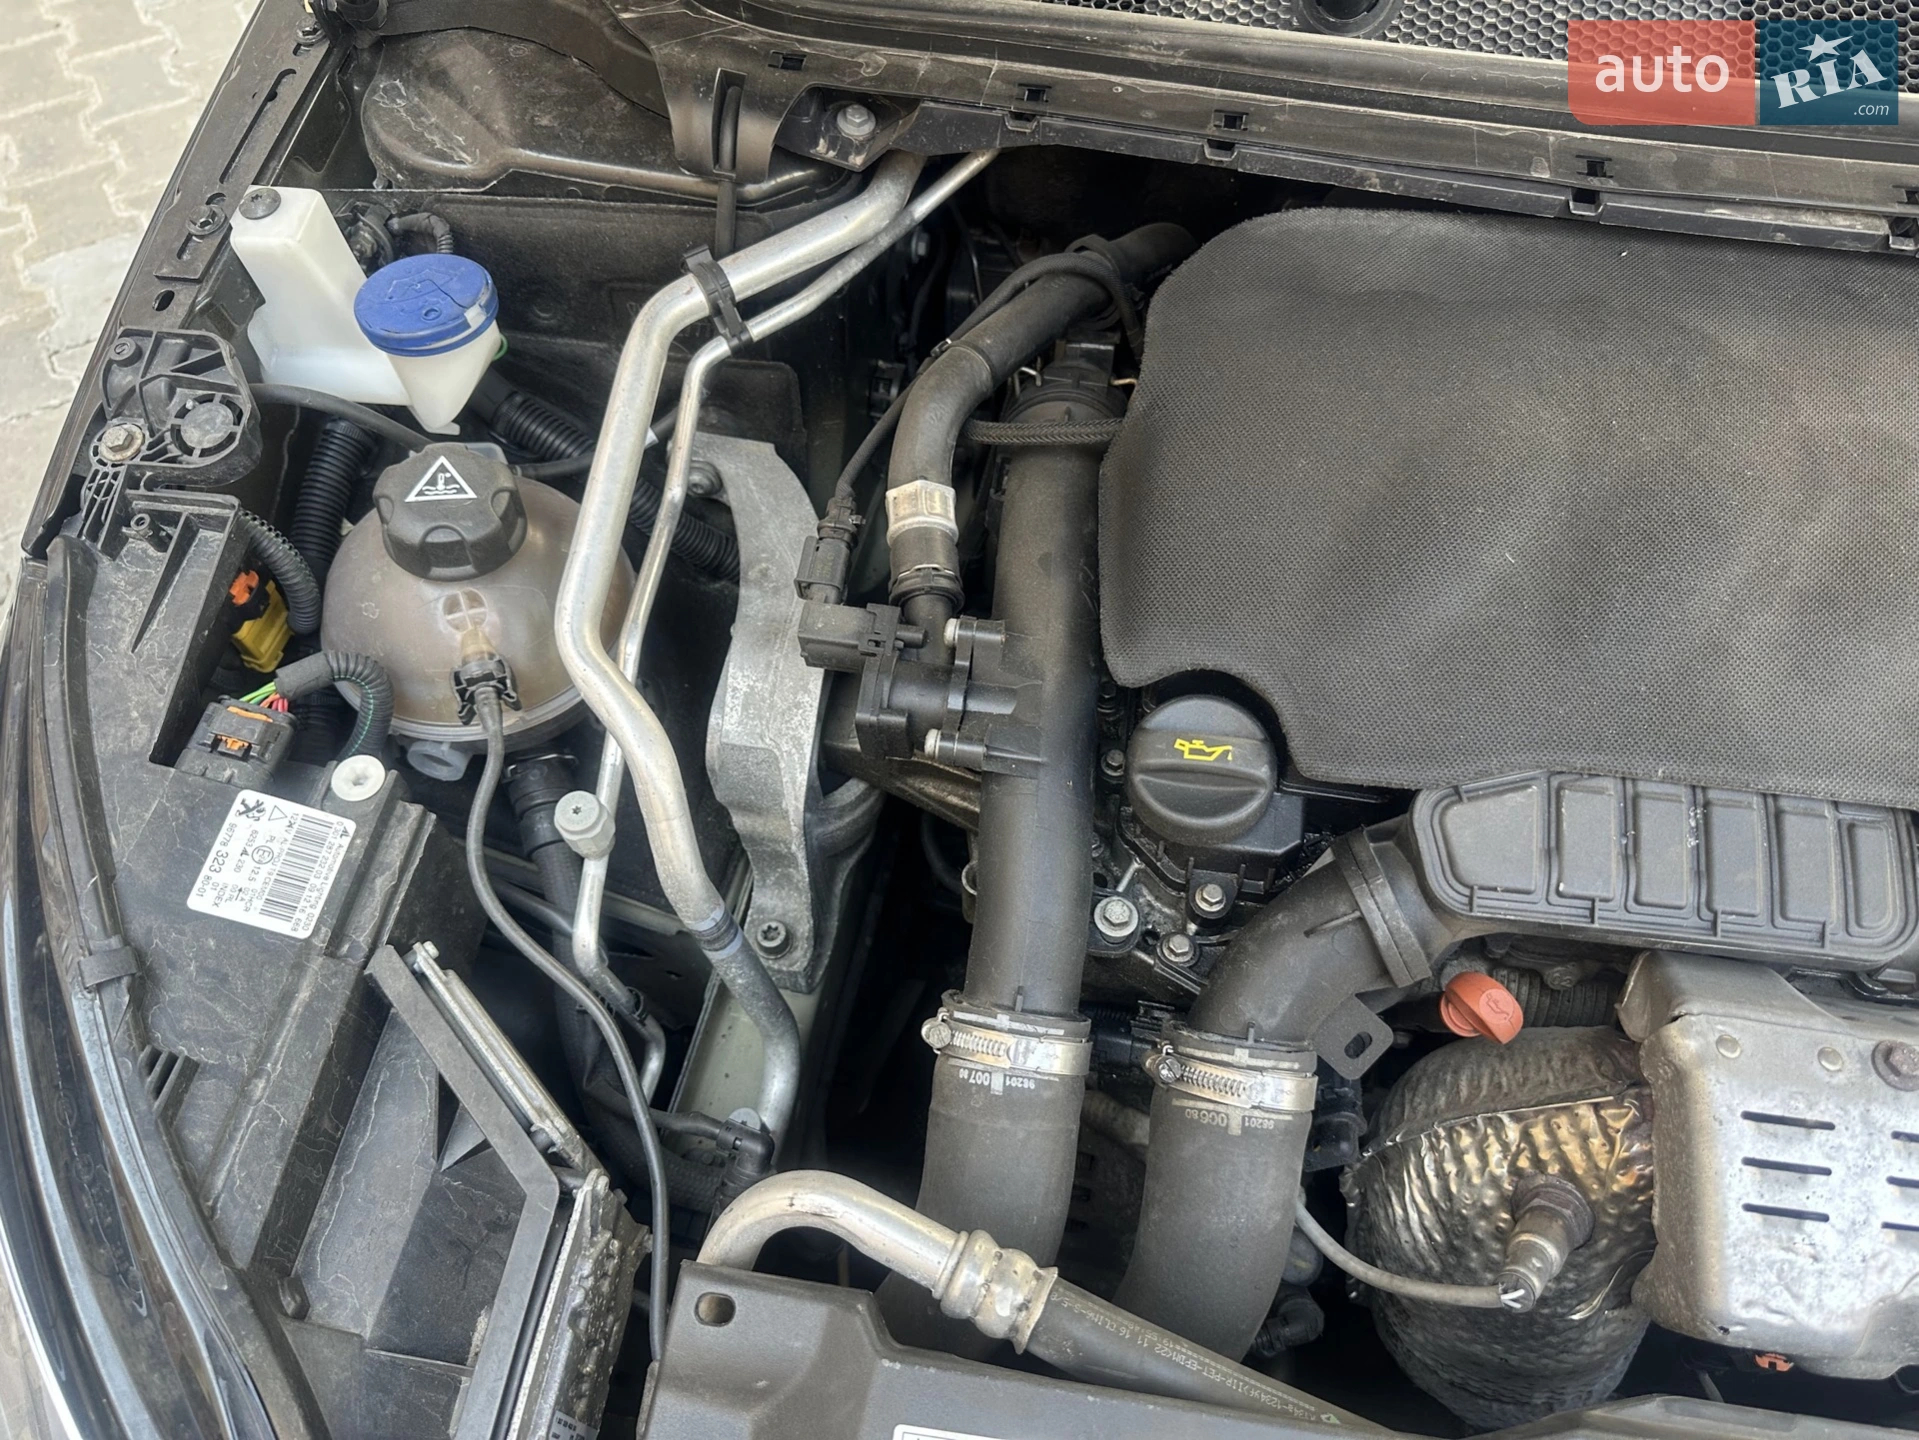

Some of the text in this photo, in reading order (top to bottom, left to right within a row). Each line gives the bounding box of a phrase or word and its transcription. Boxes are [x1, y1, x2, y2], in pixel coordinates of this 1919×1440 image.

[245, 829, 259, 847] 6253
[265, 835, 276, 844] PL
[331, 826, 341, 840] 301
[195, 822, 237, 897] 96778 323 80-01
[233, 858, 245, 873] 230
[318, 855, 329, 869] 232
[322, 843, 344, 881] Automotive
[313, 869, 323, 879] 03
[210, 881, 220, 891] 01
[212, 882, 228, 908] INDEX
[303, 894, 312, 903] 12
[298, 905, 307, 913] 16
[301, 912, 315, 931] 0230
[1118, 1325, 1128, 1339] 16
[1138, 1335, 1147, 1347] 11
